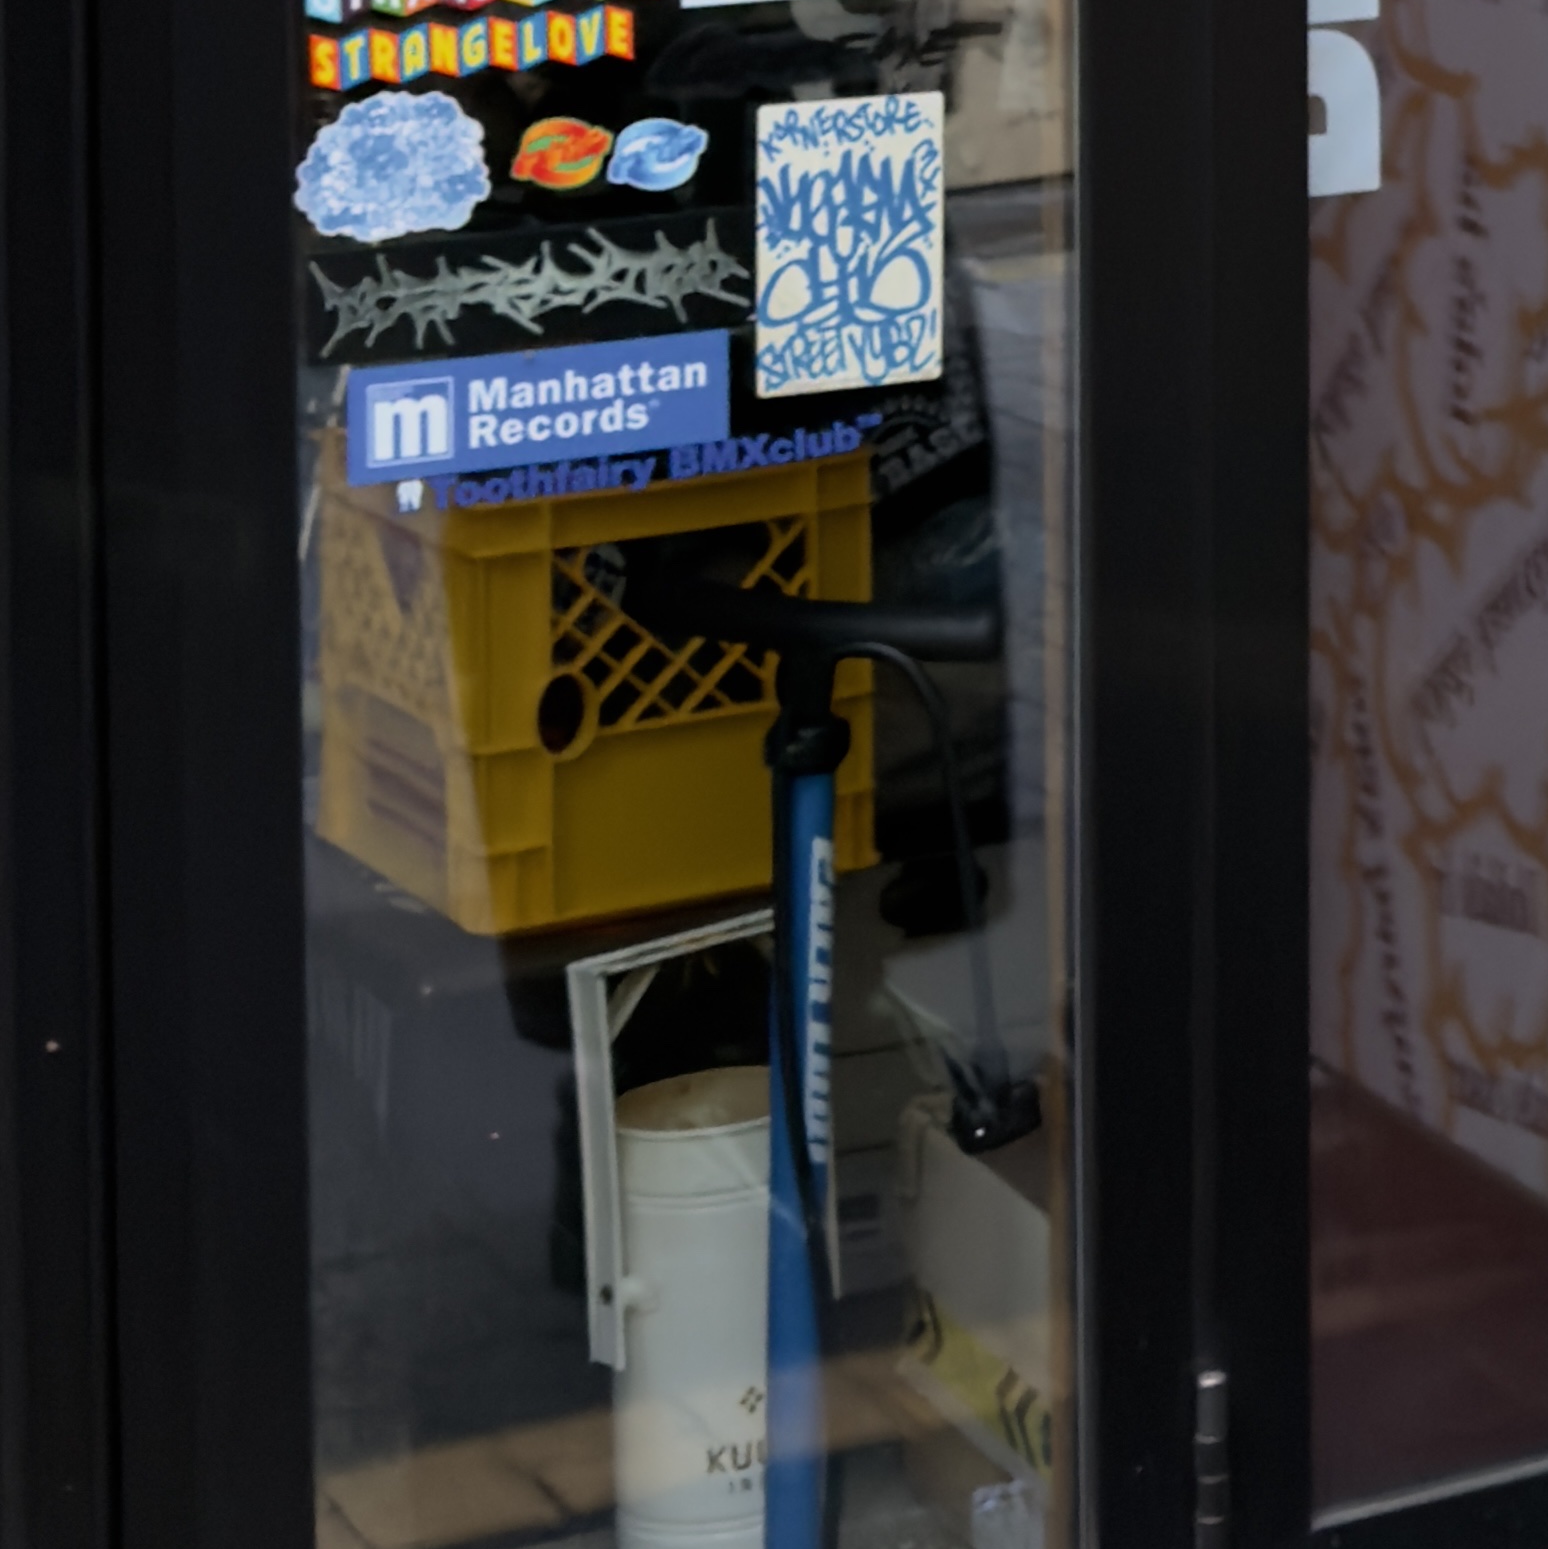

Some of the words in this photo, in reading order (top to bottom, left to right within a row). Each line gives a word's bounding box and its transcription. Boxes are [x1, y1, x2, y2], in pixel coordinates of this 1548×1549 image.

[310, 11, 632, 89] STRANGELOVE
[467, 358, 709, 415] Manhattan
[468, 402, 650, 450] Records
